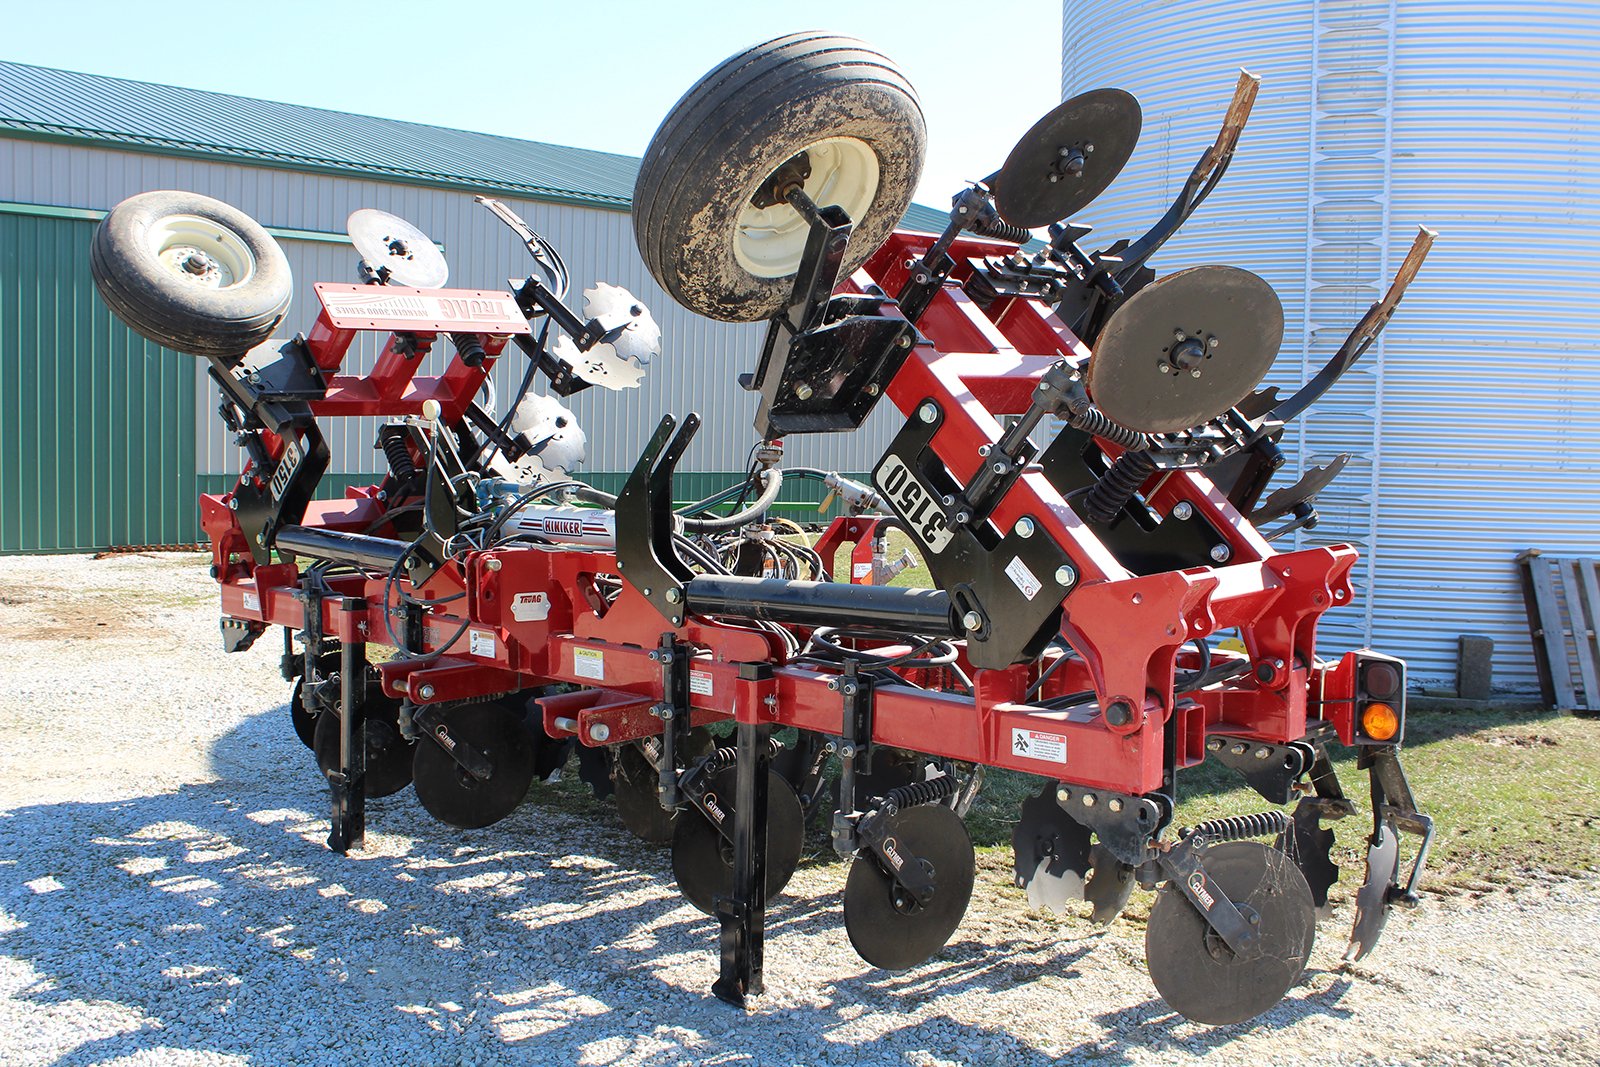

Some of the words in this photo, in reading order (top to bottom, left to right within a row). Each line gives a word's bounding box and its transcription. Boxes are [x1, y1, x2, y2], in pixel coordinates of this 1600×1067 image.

[273, 447, 298, 495] 3150
[884, 464, 947, 544] 3150
[545, 520, 580, 534] HINIKER
[1039, 734, 1060, 742] DANGER
[707, 800, 726, 821] CLYMER
[886, 845, 904, 865] CLYMER
[1192, 881, 1214, 907] CLYMER
